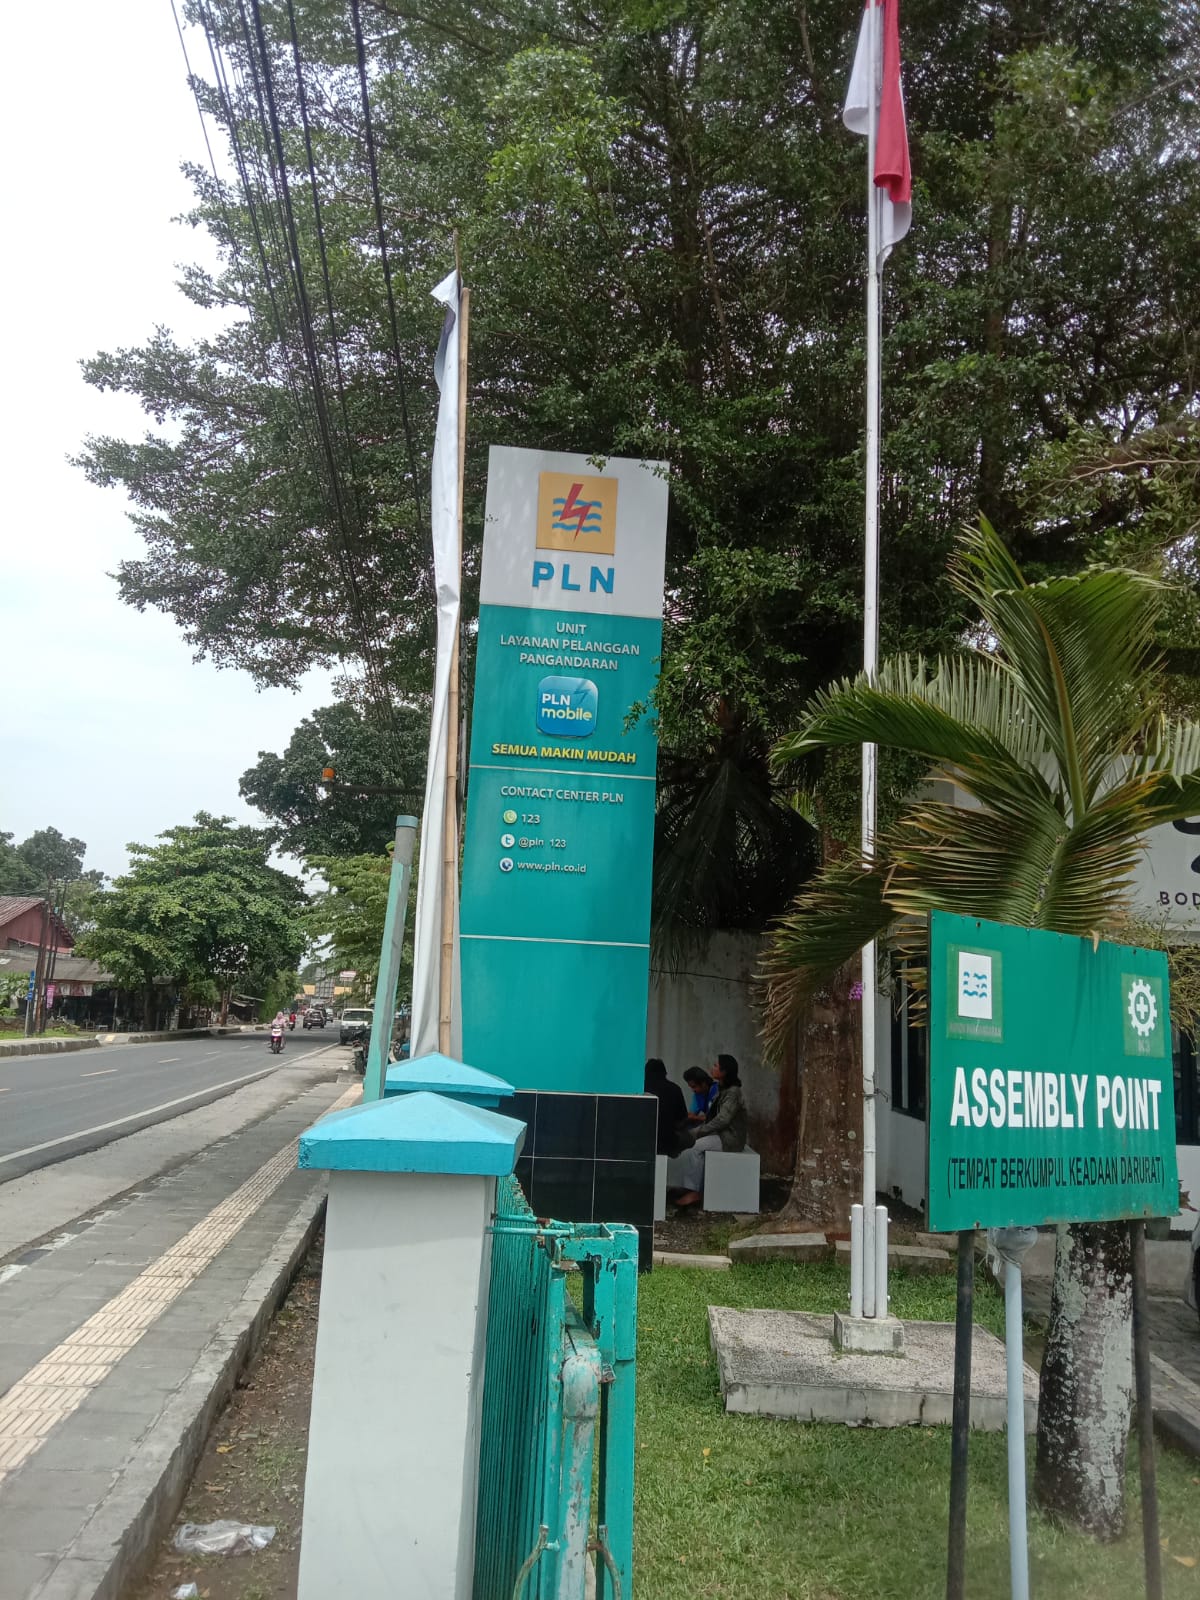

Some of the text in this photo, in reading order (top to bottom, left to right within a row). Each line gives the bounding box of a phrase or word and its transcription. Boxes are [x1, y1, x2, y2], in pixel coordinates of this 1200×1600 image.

[532, 561, 615, 594] PLN
[556, 622, 587, 635] UNIT
[500, 634, 640, 655] LAYANAN PELANGGAN
[519, 652, 618, 670] PANGANDARAN
[541, 693, 571, 706] PLN
[541, 707, 593, 721] mobile
[492, 743, 637, 763] SEMUA MAKIN MUDAH
[501, 785, 624, 803] CONTACT CENTER PLN
[521, 813, 541, 824] 123
[517, 861, 587, 873] www.pln.co.id
[950, 1067, 1162, 1130] ASSEMBLY POINT
[948, 1156, 1165, 1199] (TEMPAT BERKUMPUL KEADAAN DARURAT)
